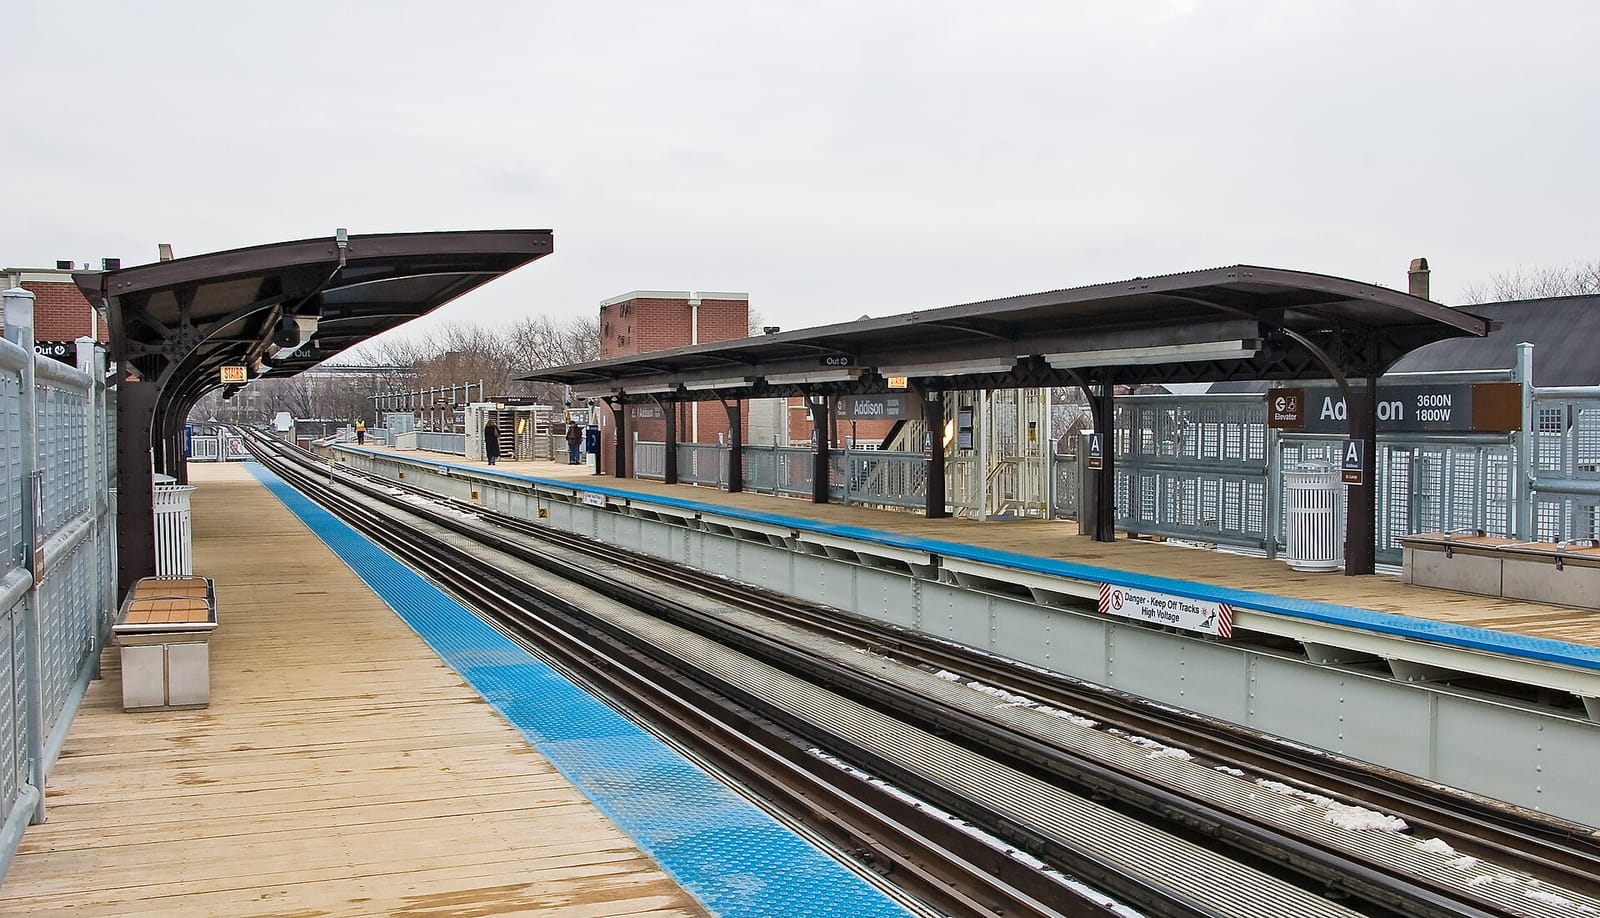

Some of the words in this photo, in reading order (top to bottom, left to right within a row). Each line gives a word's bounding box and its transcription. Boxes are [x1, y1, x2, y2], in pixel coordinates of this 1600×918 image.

[34, 345, 52, 355] Out
[294, 349, 311, 358] Out
[826, 356, 840, 365] Out
[224, 367, 244, 379] STAIRS
[1417, 394, 1452, 407] 3600N
[854, 400, 884, 416] Addison
[1320, 396, 1404, 421] Adon
[1274, 413, 1297, 421] Elevator
[1415, 408, 1452, 422] 1800W
[925, 433, 931, 446] A
[1091, 435, 1100, 451] A
[1346, 441, 1358, 461] A
[539, 509, 546, 518] 2
[1124, 592, 1146, 605] Danger
[1150, 597, 1167, 609] Keep
[1167, 599, 1178, 609] Off
[1178, 601, 1200, 615] Tracks
[1141, 606, 1156, 619] High
[1156, 608, 1180, 624] Voltage
